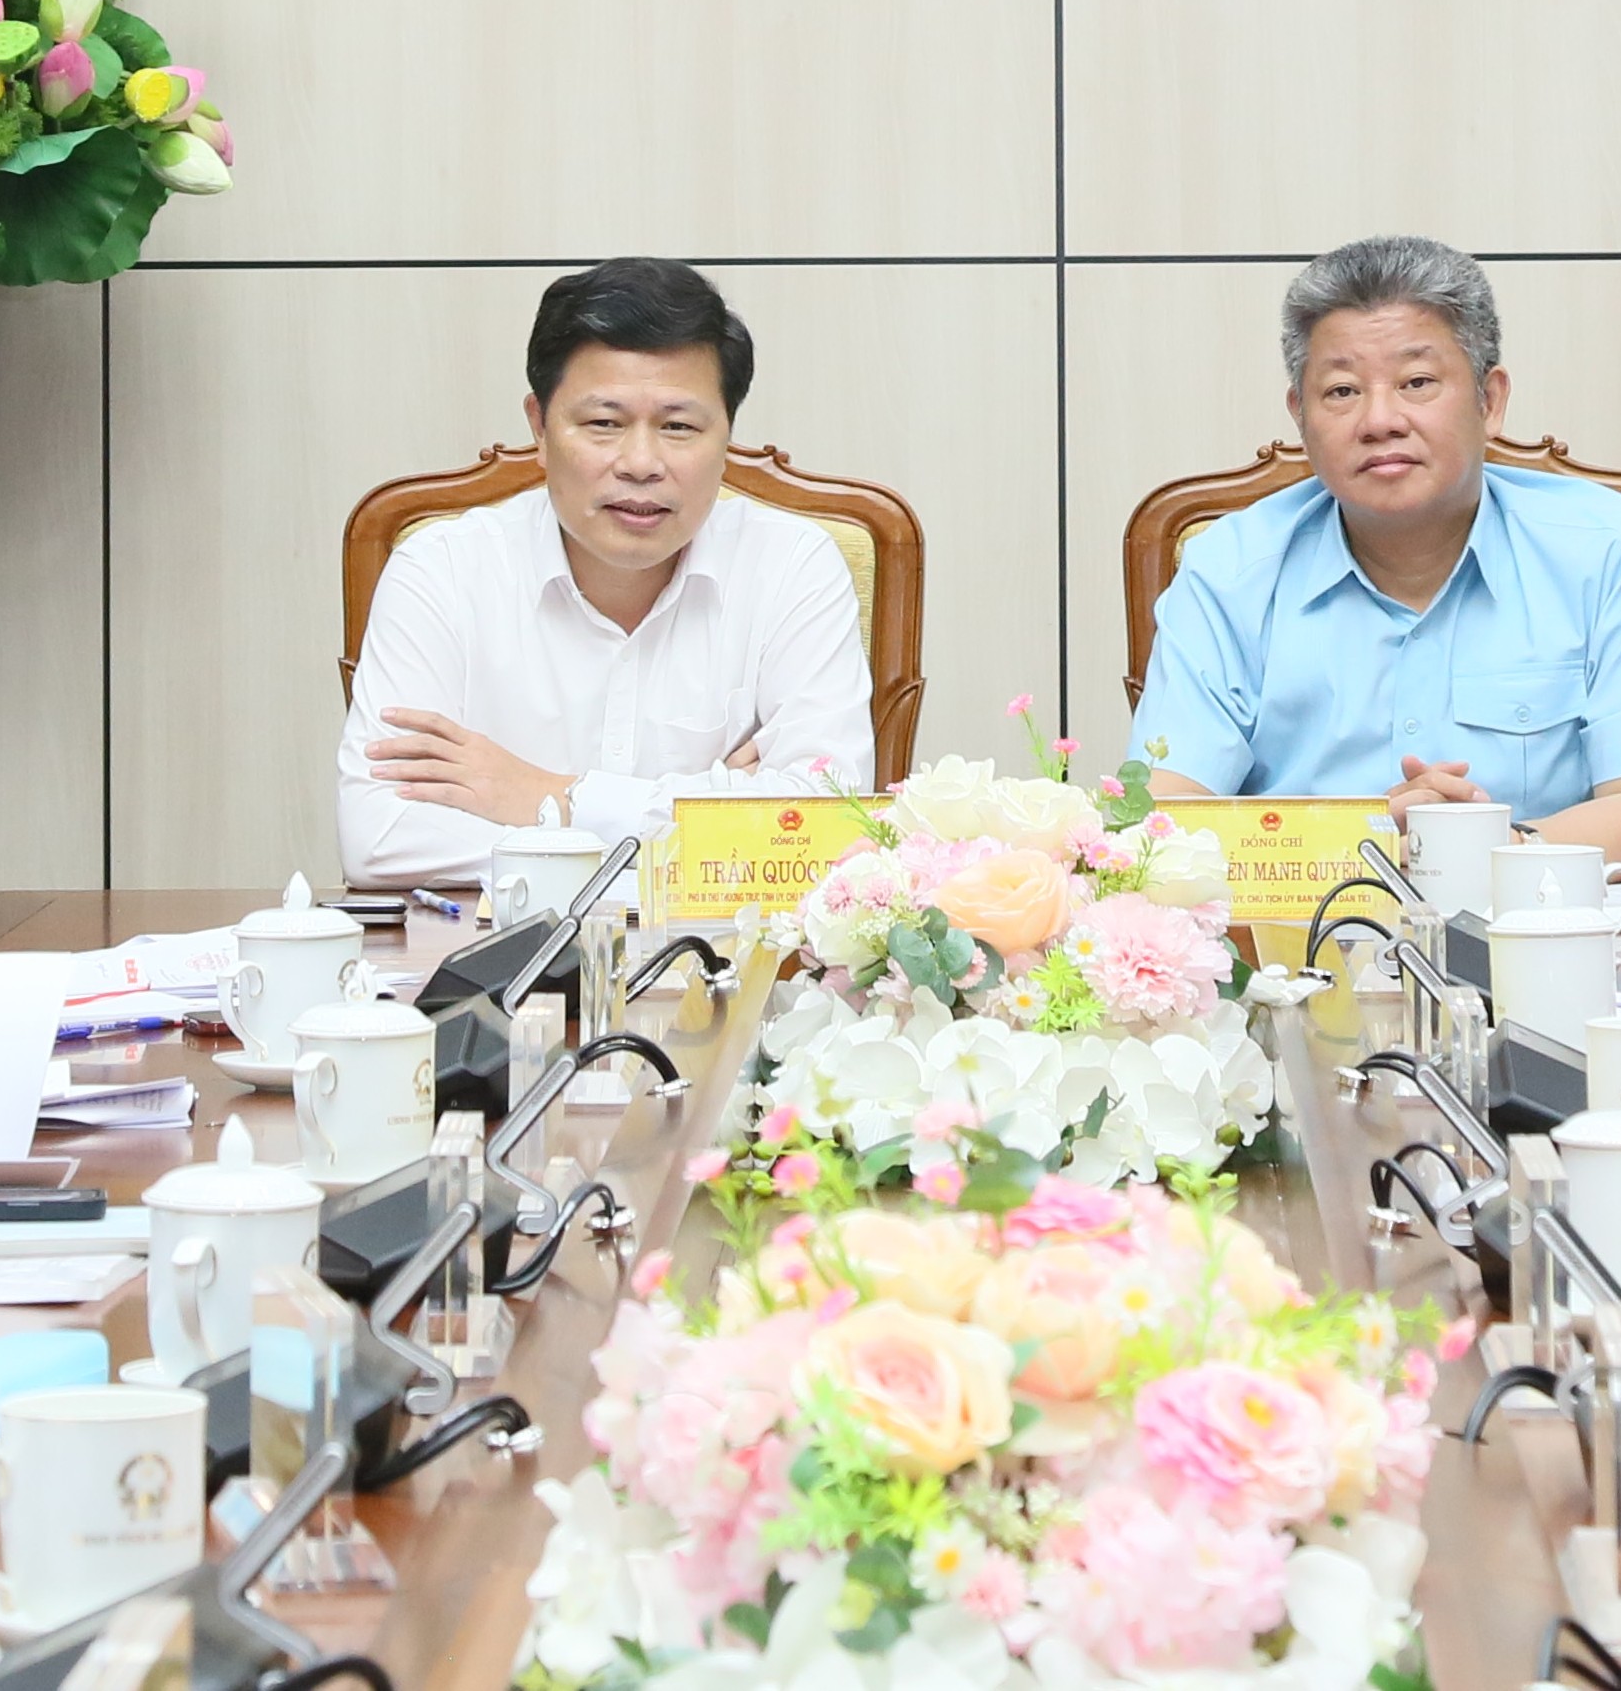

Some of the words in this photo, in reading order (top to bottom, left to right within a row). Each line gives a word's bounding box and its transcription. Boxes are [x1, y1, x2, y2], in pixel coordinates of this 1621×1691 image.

[1280, 834, 1303, 848] CHÍ
[700, 847, 757, 884] TRẦN
[762, 848, 820, 885] QUỐC
[1253, 861, 1303, 886] MẠNH
[1297, 894, 1312, 903] BAN
